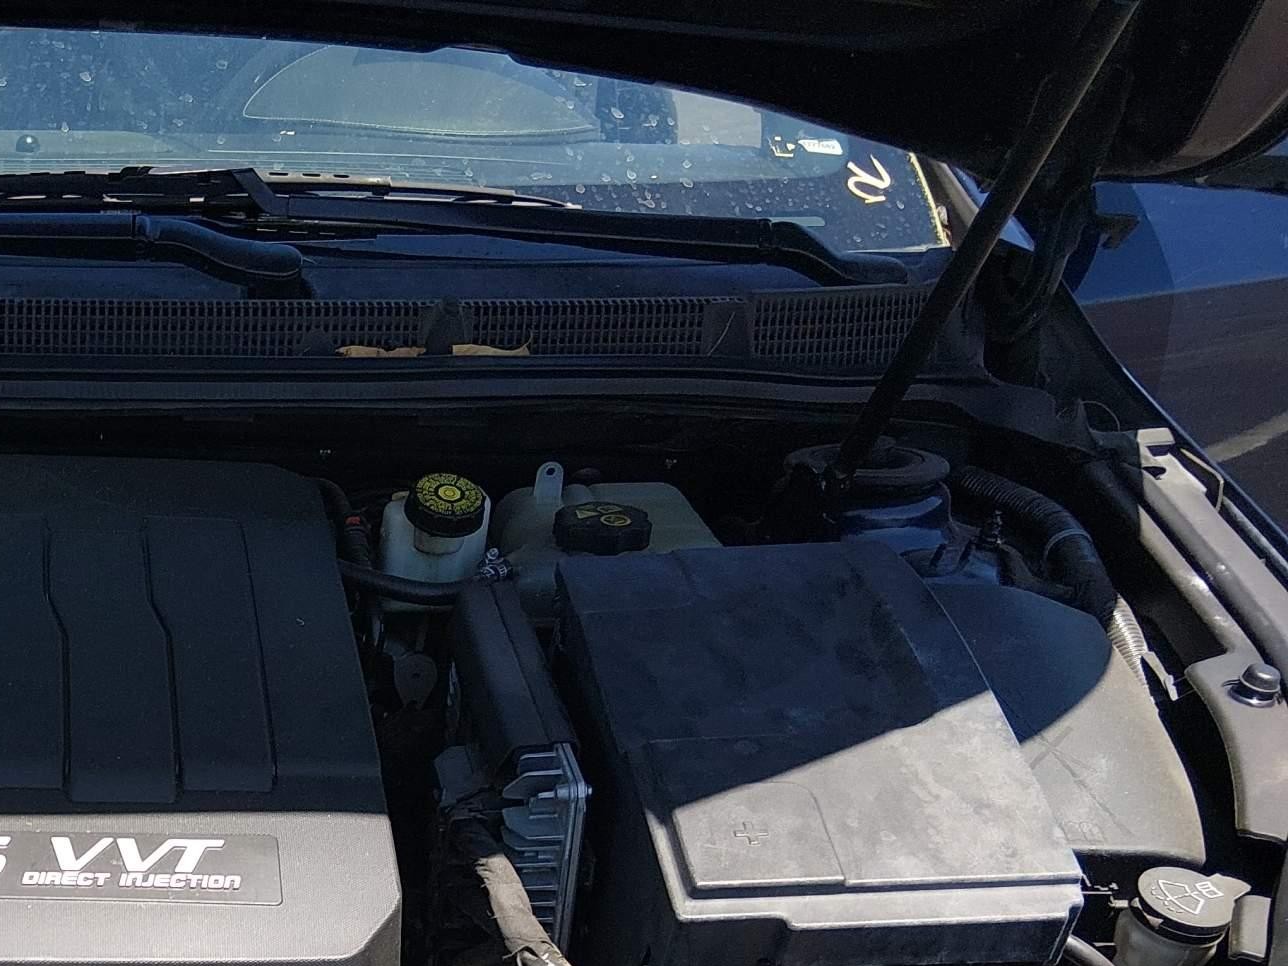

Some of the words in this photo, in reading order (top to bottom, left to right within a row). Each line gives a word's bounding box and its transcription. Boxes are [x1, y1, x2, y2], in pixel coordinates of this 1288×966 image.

[50, 836, 226, 873] VVT
[21, 869, 112, 888] DIRECT
[118, 871, 242, 890] INJECTION
